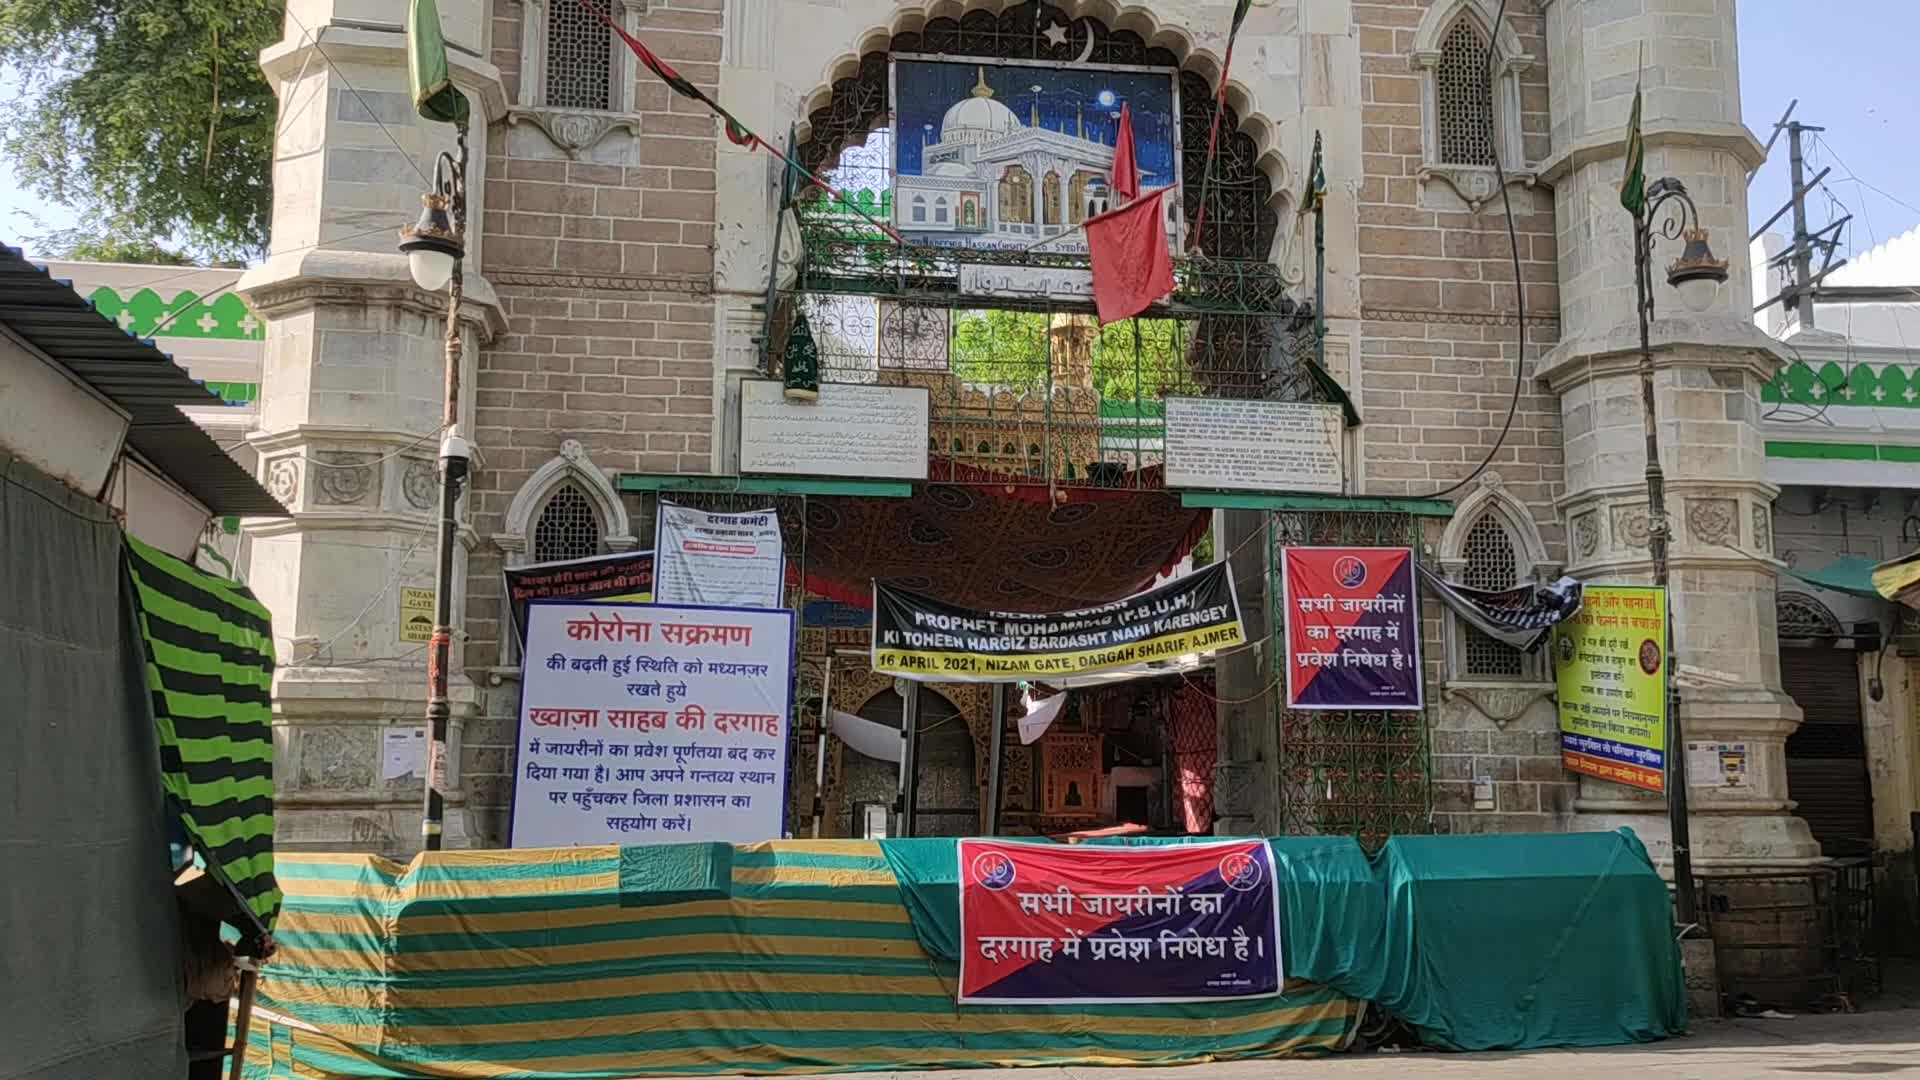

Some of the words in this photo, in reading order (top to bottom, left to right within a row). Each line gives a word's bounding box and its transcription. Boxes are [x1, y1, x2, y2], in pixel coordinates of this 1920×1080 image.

[707, 515, 738, 525] दरगाह
[408, 599, 432, 608] GATE
[1298, 593, 1336, 614] सभी
[1339, 593, 1405, 614] जायरीनों
[567, 612, 652, 643] कोरोना
[661, 614, 752, 646] संक्रमण
[884, 630, 900, 644] KI
[903, 631, 964, 649] TOHEEN
[967, 635, 1025, 651] HARGIZ
[1029, 630, 1107, 650] BARDASHT
[1112, 623, 1150, 642] NAHI
[1153, 604, 1228, 634] KARENGEY
[915, 610, 999, 633] PROPHET
[1306, 625, 1333, 640] का
[1335, 626, 1382, 643] दरगाह
[1385, 622, 1400, 641] में
[879, 654, 895, 666] 16
[899, 655, 939, 669] APRIL
[944, 657, 982, 672] 2021,
[986, 659, 1030, 671] NIZAM
[1034, 657, 1075, 671] GATE,
[1078, 647, 1135, 668] DARGAH
[1192, 627, 1239, 648] AJMER
[1296, 647, 1339, 669] प्रवेश
[1343, 647, 1389, 669] निषेध
[546, 653, 566, 671] की
[571, 655, 608, 675] बढ़ती
[612, 655, 632, 677] हुई
[636, 656, 678, 674] स्थिति
[684, 657, 702, 674] को
[626, 680, 661, 697] रखते
[666, 682, 687, 702] हुये
[529, 707, 599, 731] ख्वाज़ा
[608, 709, 668, 733] साहब
[675, 704, 706, 731] की
[714, 712, 780, 737] दरगाह
[529, 737, 541, 755] में
[545, 738, 604, 757] जायरीनों
[609, 742, 629, 757] का
[634, 741, 668, 759] प्रवेश
[673, 741, 722, 764] पूर्णतया
[728, 743, 748, 761] बंद
[753, 748, 776, 761] कर
[526, 762, 556, 780] दिया
[562, 765, 589, 781] गया
[616, 766, 645, 783] आप
[650, 766, 685, 783] अपने
[690, 768, 734, 784] गन्तव्य
[739, 769, 776, 785] स्थान
[548, 791, 568, 805] पर
[572, 787, 627, 811] पहुँचकर
[632, 788, 668, 807] जिला
[673, 792, 727, 809] प्रशासन
[731, 792, 751, 808] का
[606, 815, 656, 832] सहयोग
[1016, 885, 1073, 916] सभी
[1080, 885, 1183, 917] जायरीनों
[1189, 892, 1224, 915] का
[977, 936, 1055, 963] दरगाह
[1059, 928, 1083, 961] में
[1086, 928, 1152, 962] प्रवेश
[1158, 932, 1226, 960] निषेध
